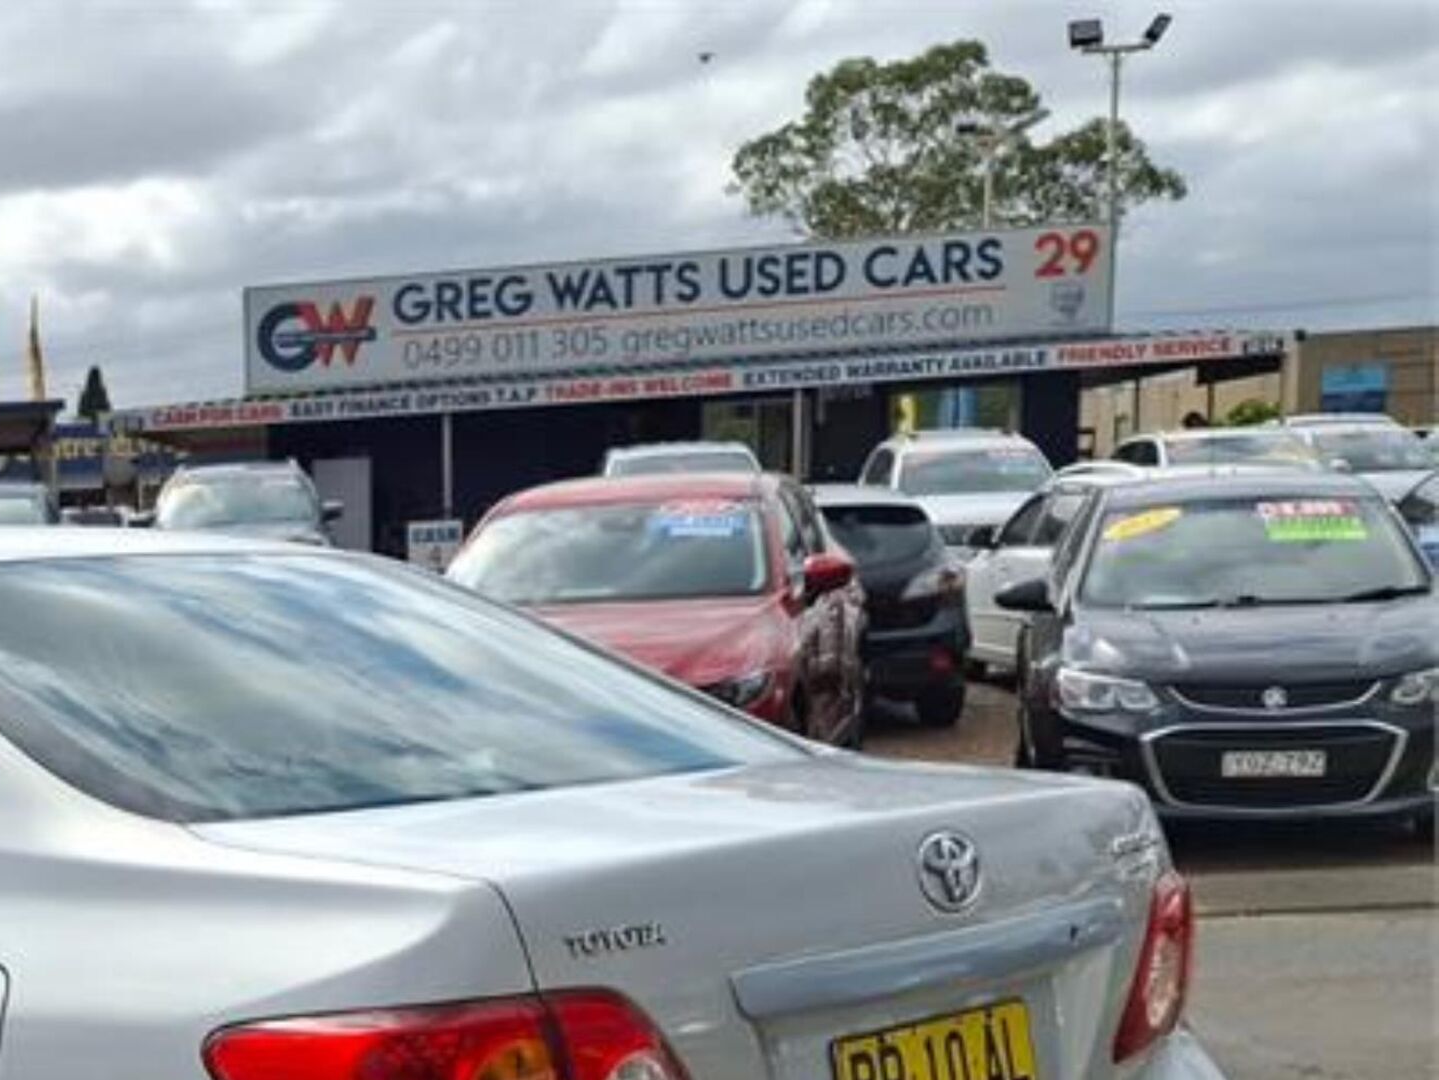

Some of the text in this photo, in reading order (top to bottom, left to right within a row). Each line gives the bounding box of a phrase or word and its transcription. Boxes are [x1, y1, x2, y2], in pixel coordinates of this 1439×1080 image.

[393, 239, 1003, 324] GREG WATTS USED CARS
[1034, 231, 1099, 278] 29
[257, 297, 375, 372] GW
[404, 301, 994, 370] 0499 011 305 gregwattsusedcars.com
[846, 357, 943, 381] WARRANTY
[948, 350, 1046, 373] AVAILABLE
[1056, 343, 1146, 363] FRIENDLY
[1152, 337, 1231, 357] SERVICE
